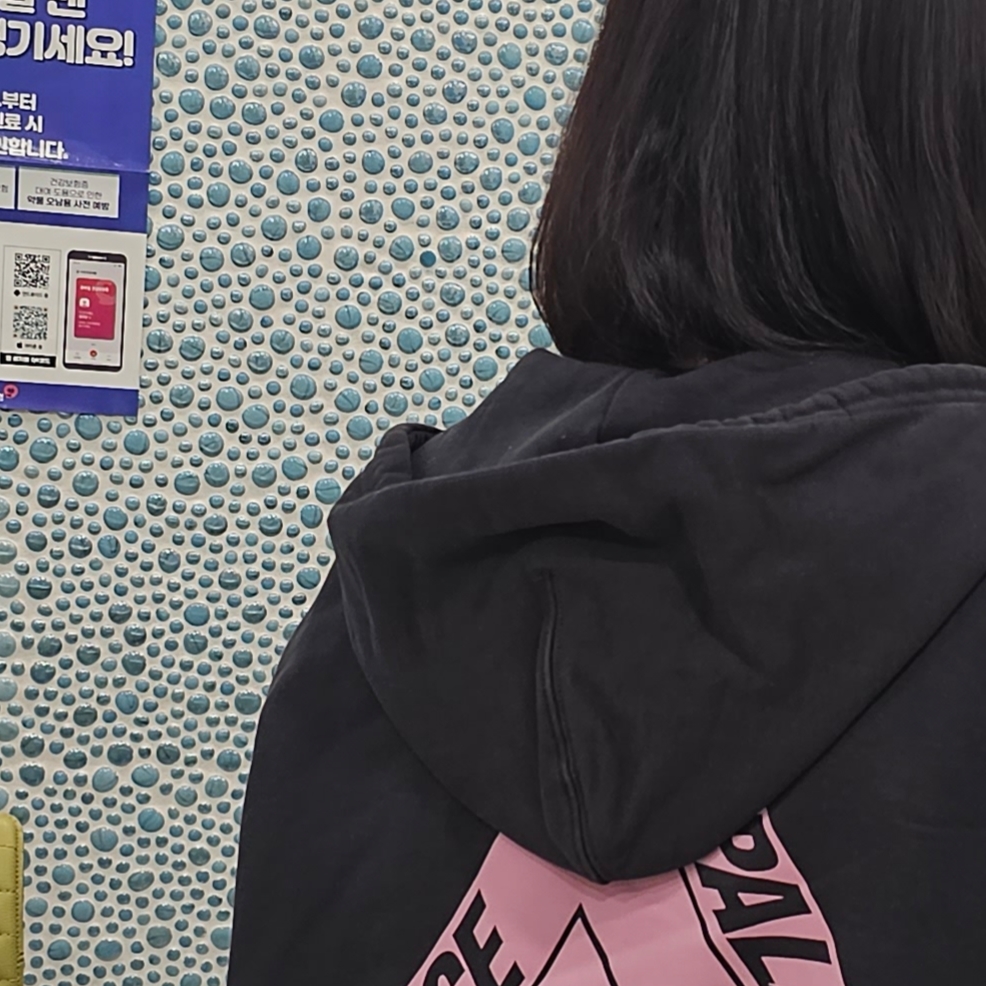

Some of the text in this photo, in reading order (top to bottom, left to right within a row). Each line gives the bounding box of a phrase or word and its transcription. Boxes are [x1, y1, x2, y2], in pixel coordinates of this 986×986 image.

[0, 91, 37, 111] 부터
[0, 112, 43, 133] 료 시
